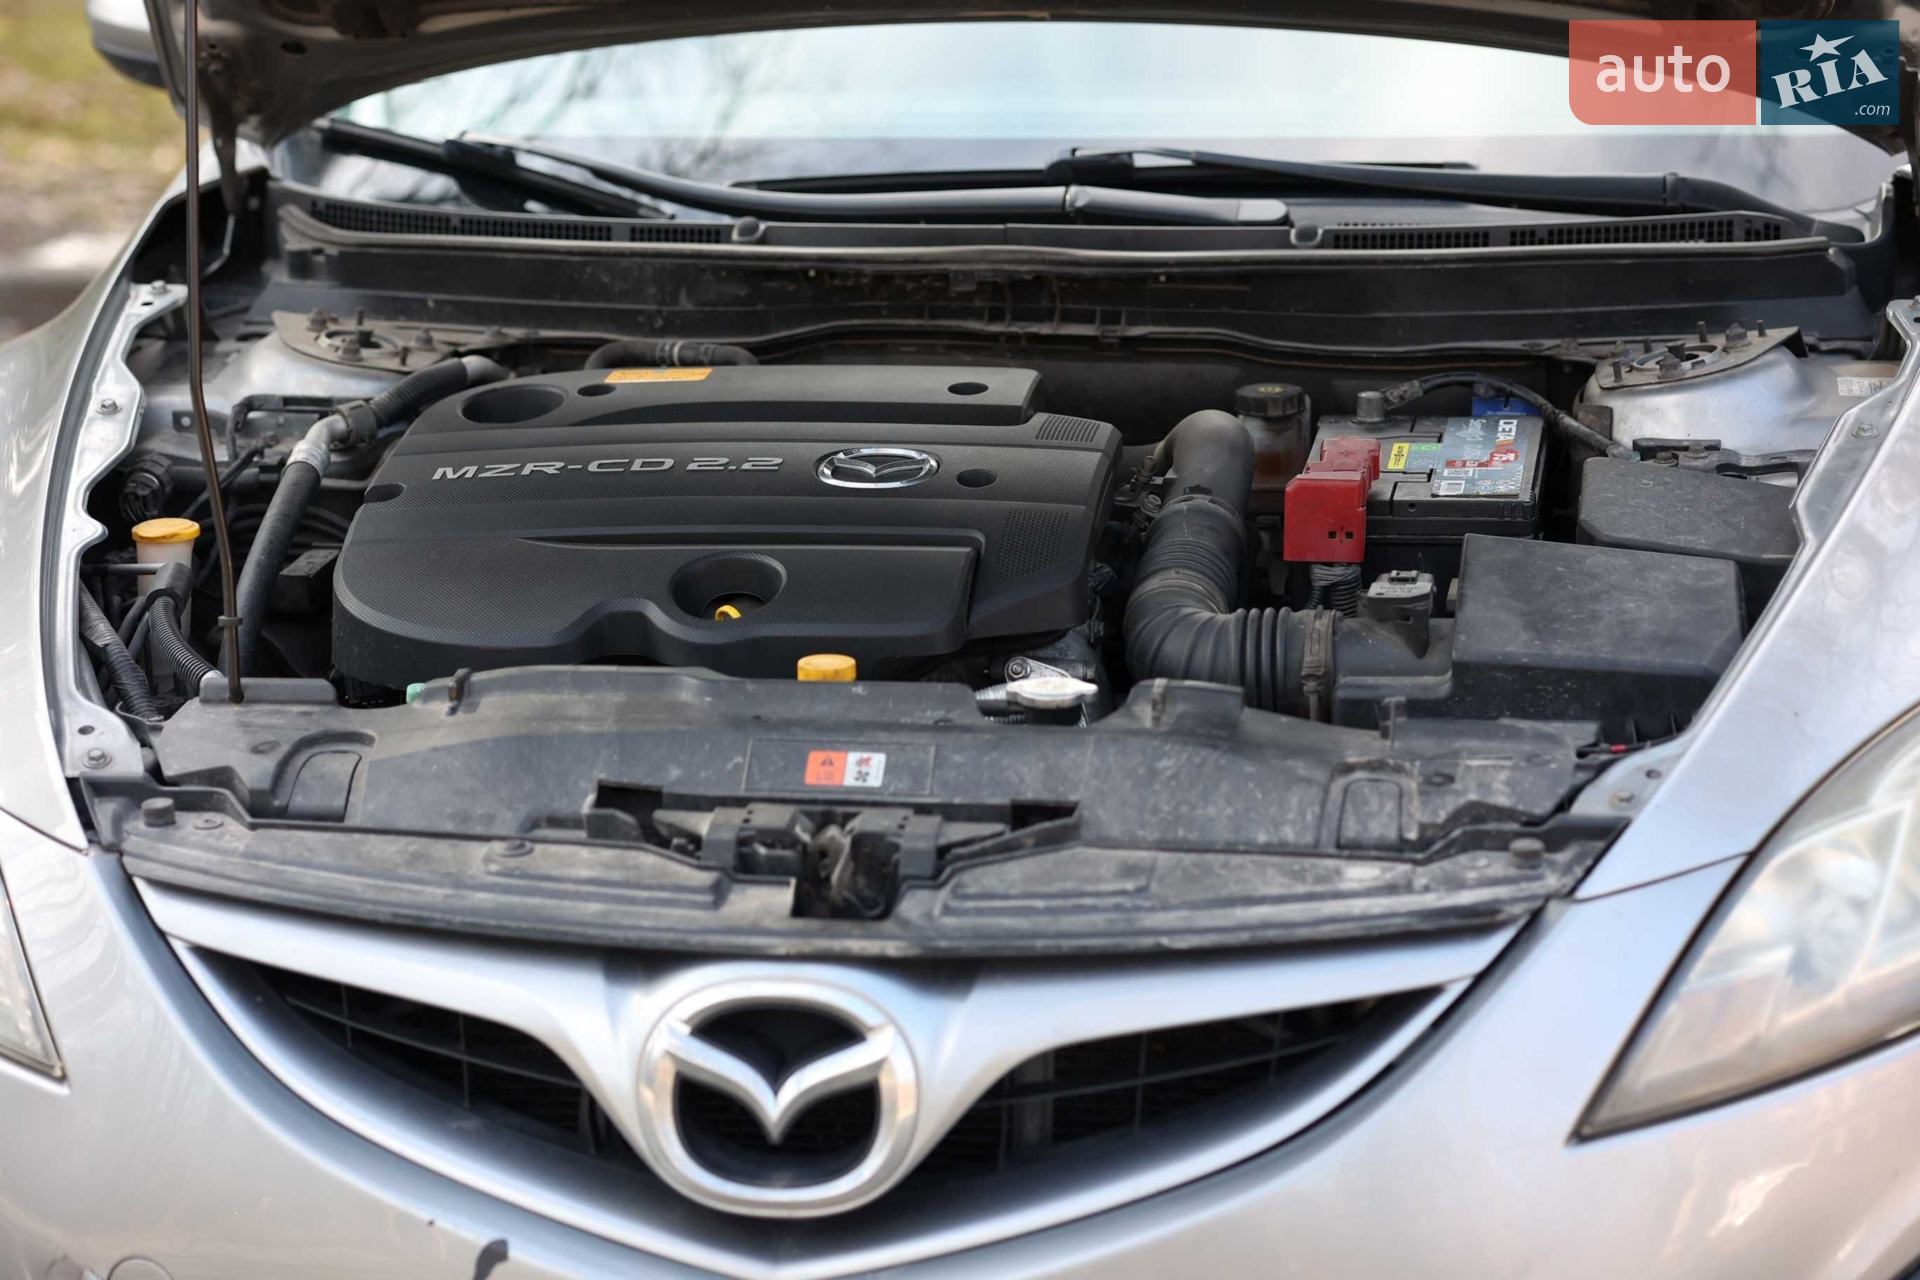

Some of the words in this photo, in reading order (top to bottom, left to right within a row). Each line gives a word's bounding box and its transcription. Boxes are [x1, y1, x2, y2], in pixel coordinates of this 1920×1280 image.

[1495, 419, 1518, 442] DETA
[431, 457, 675, 480] MZR-CD
[685, 456, 785, 471] 2.2
